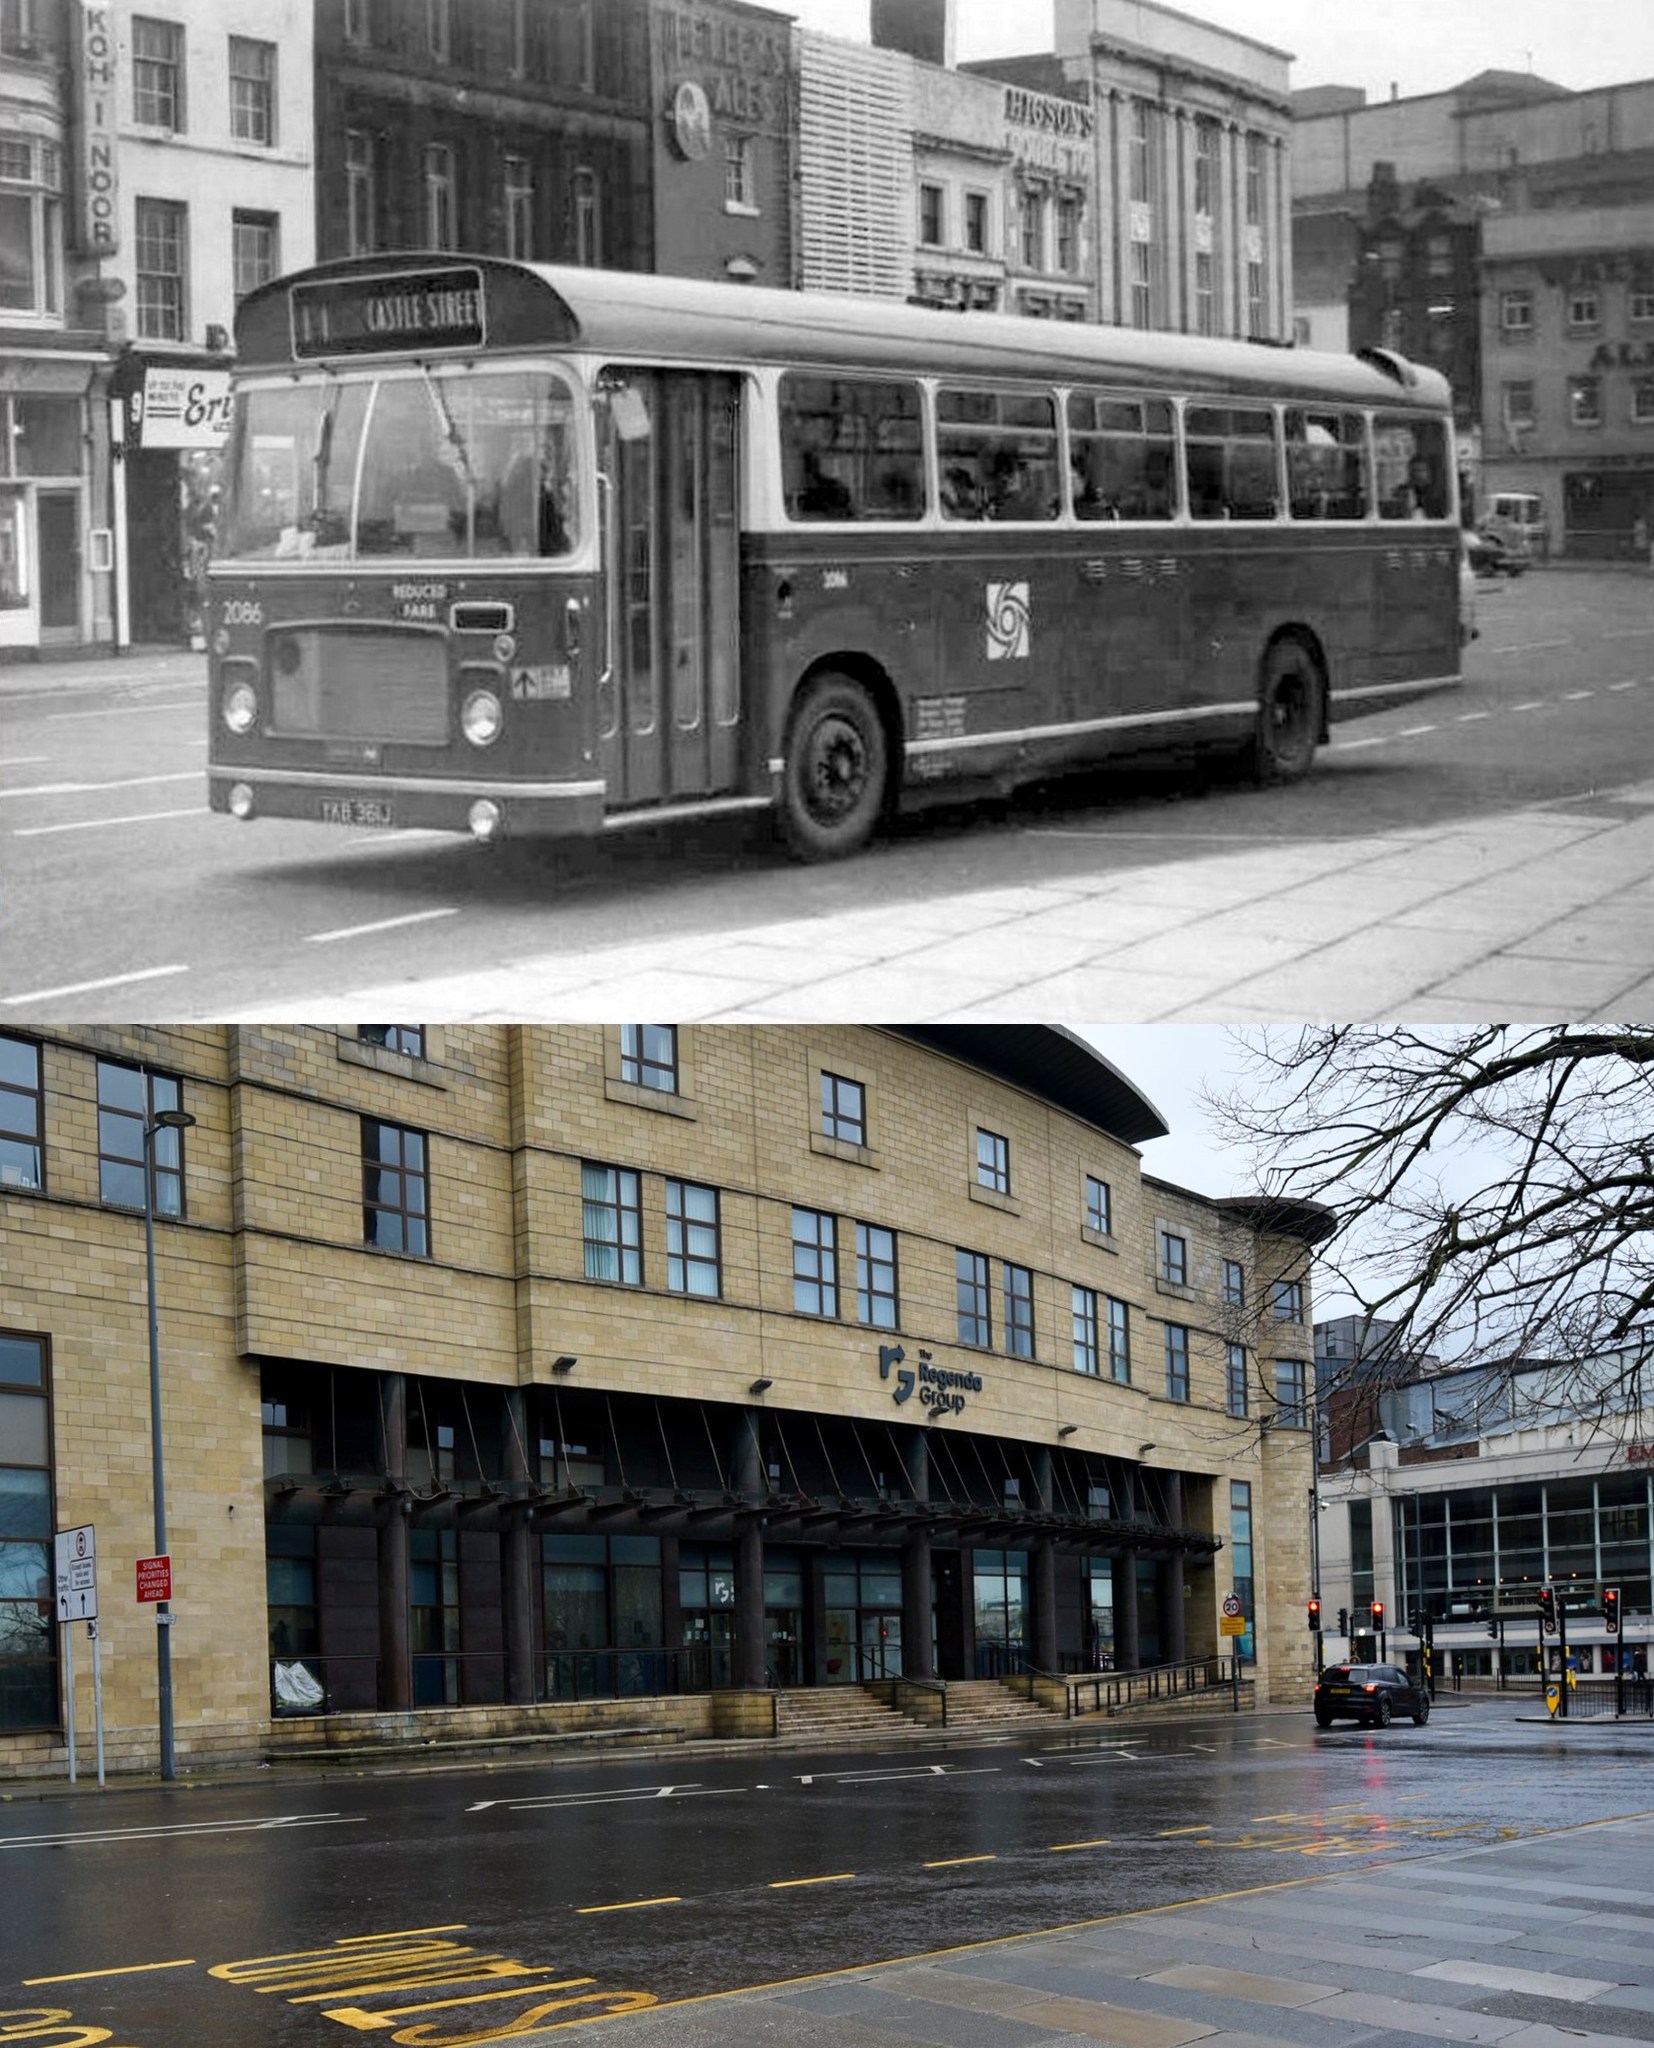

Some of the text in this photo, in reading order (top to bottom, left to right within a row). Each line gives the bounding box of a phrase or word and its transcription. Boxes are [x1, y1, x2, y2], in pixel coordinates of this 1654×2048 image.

[366, 295, 423, 332] CASTLE
[392, 583, 448, 599] REDUCED
[403, 602, 437, 618] FARE
[919, 1348, 933, 1360] The
[918, 1362, 983, 1392] Regenda
[919, 1385, 966, 1415] Group
[142, 1560, 164, 1570] SIGNAL
[137, 1569, 169, 1580] PRIORITIES
[139, 1579, 168, 1590] CHANGED
[143, 1589, 165, 1598] AHEAD
[1226, 1603, 1238, 1611] 20
[207, 1939, 659, 2047] STAND
